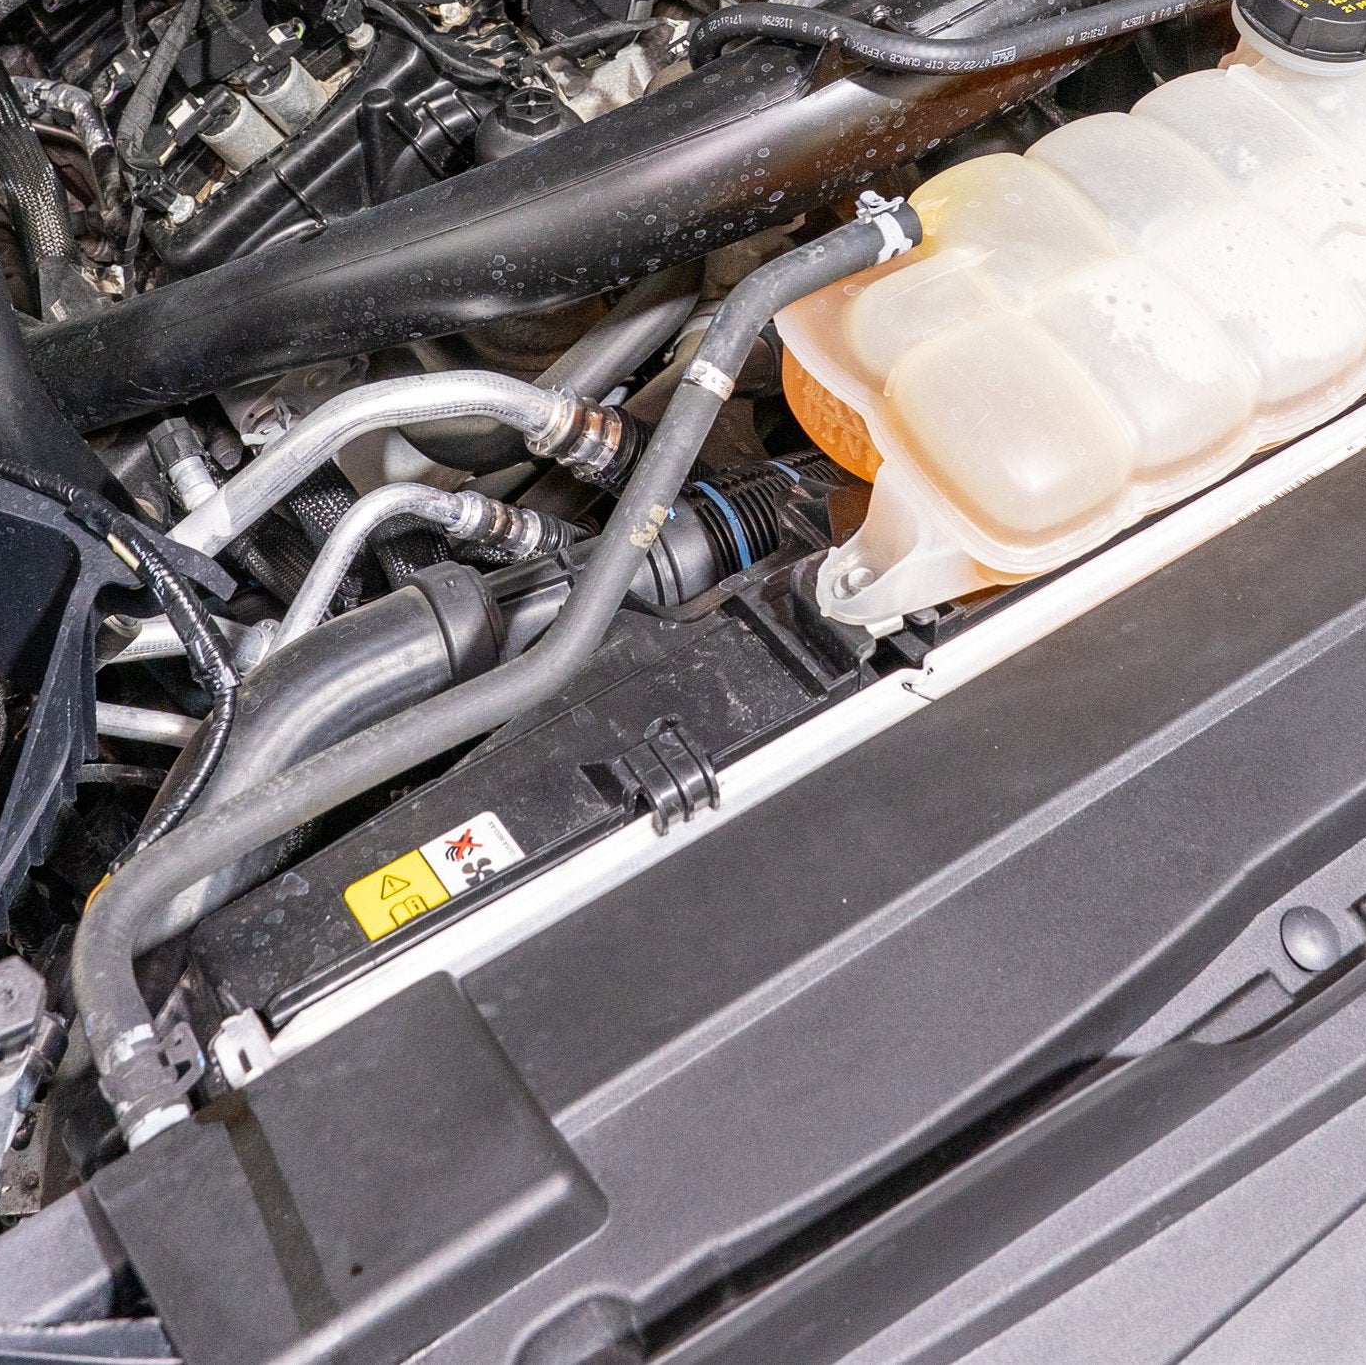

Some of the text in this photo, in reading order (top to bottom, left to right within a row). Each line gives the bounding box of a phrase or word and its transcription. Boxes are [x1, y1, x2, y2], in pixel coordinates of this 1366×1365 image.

[1341, 4, 1354, 13] 21
[760, 14, 793, 28] 1126790
[923, 58, 944, 69] CIP
[945, 59, 991, 69] 07/22/22
